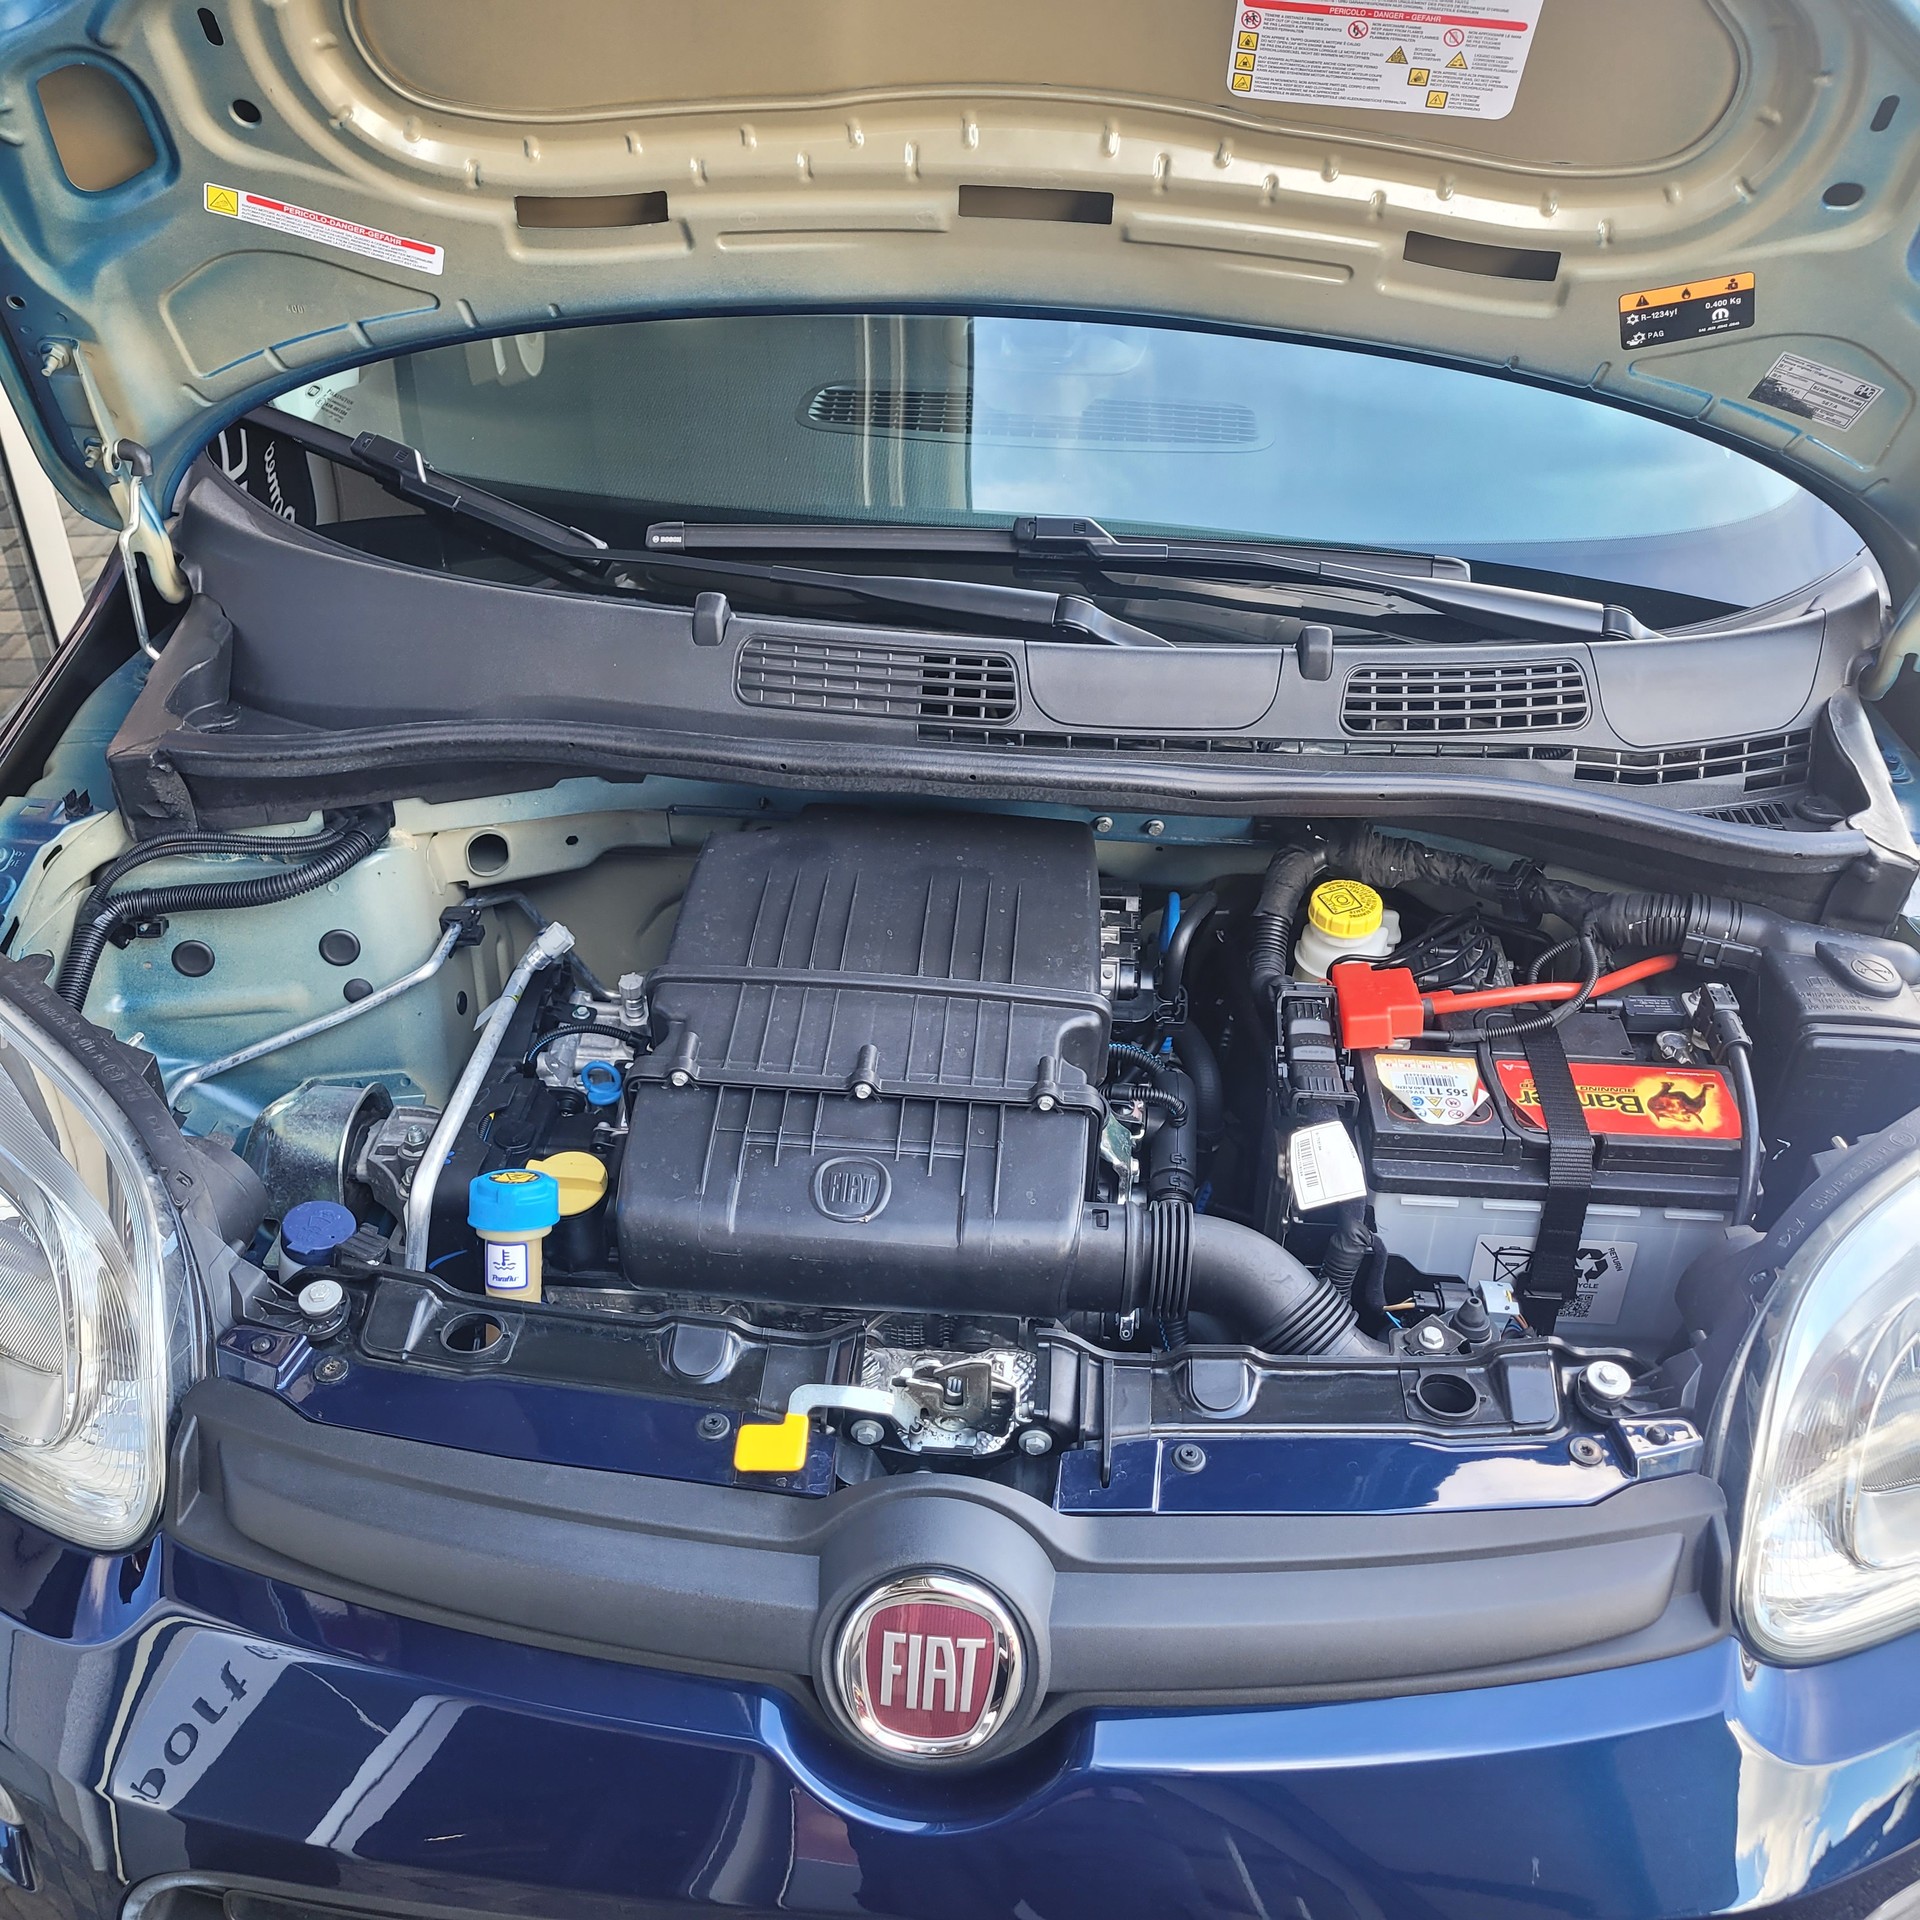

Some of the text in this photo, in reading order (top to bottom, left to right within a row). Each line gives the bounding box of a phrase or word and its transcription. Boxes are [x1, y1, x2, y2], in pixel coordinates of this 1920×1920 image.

[1329, 7, 1441, 22] PERICOLO DANGER GEFAHR
[281, 204, 404, 246] PERICOLO-DANGER-GEFAHR
[1704, 296, 1741, 309] 0.400 Kg
[1640, 307, 1678, 321] R-1234yf
[1646, 330, 1664, 338] PAG
[1428, 1087, 1468, 1097] 565 11
[1519, 1090, 1644, 1114] Baner
[828, 1172, 876, 1204] FIAT
[1608, 1248, 1622, 1272] RETURN
[880, 1630, 986, 1713] FIAT
